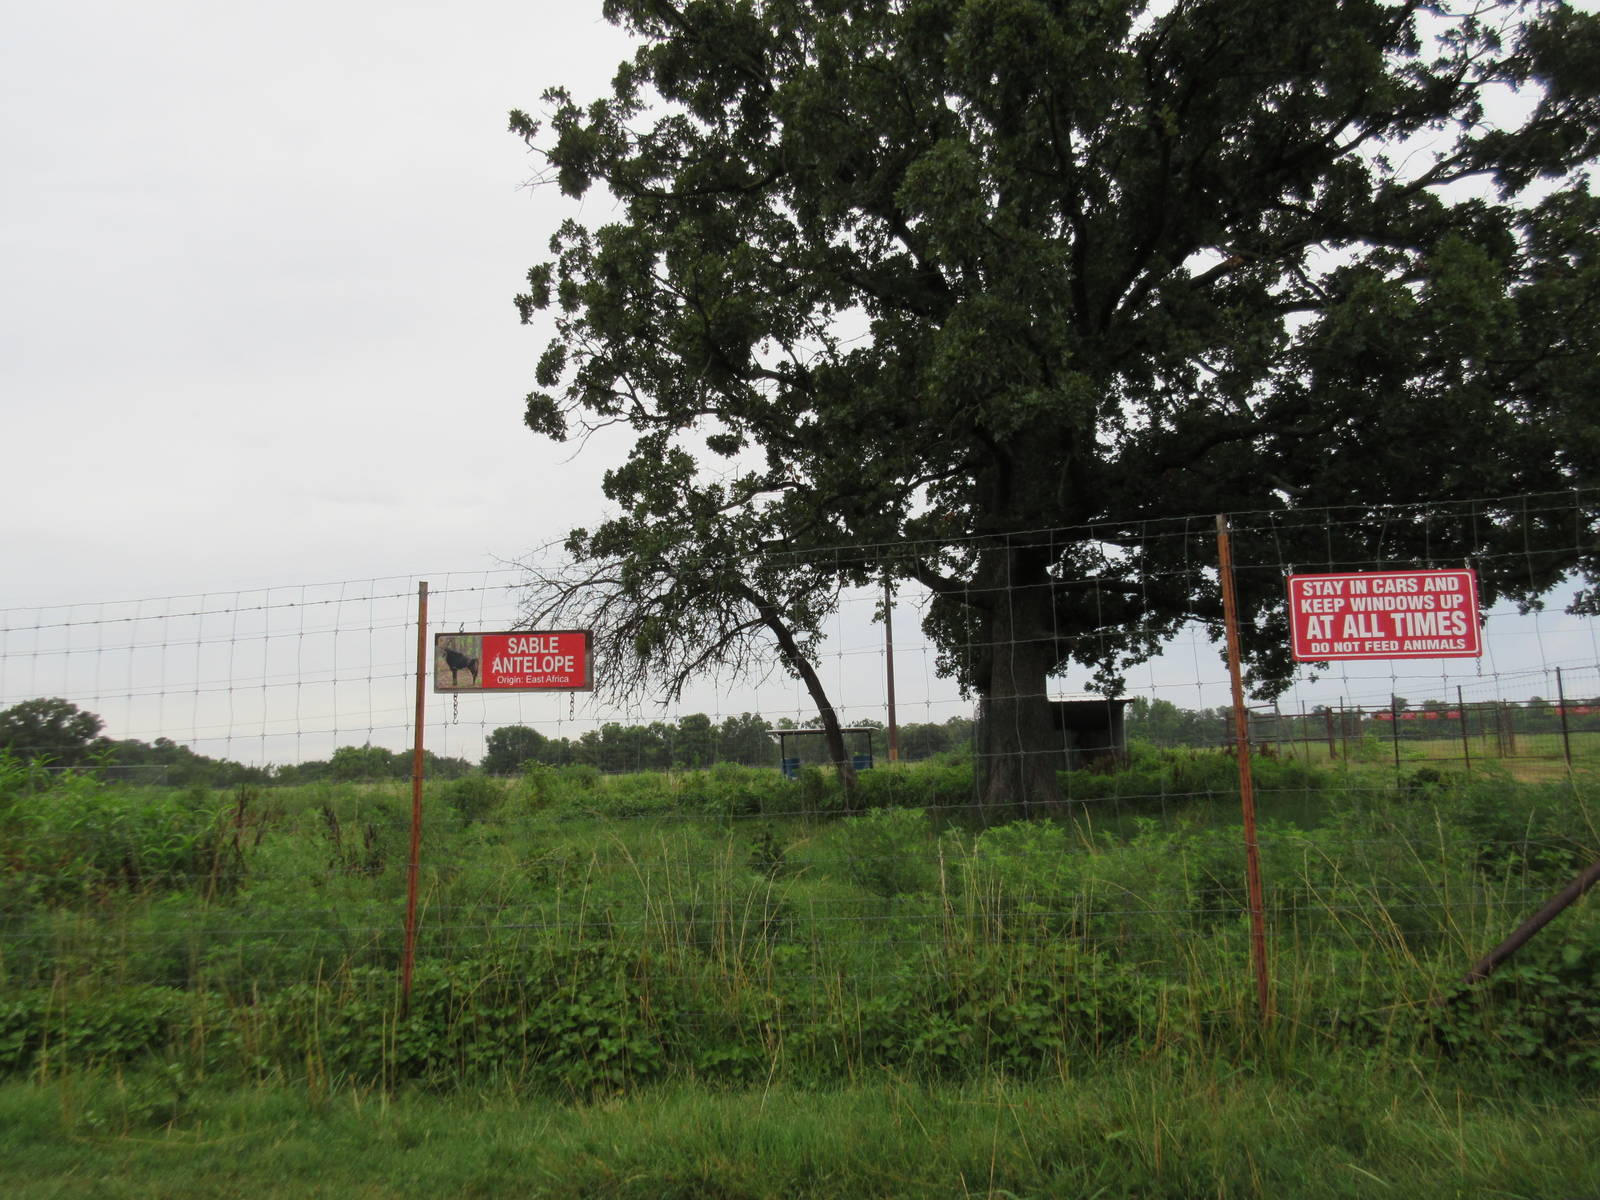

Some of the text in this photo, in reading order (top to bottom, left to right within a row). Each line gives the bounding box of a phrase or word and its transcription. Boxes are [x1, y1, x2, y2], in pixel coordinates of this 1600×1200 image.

[1302, 576, 1459, 596] STAY IN CARS AND
[1301, 594, 1464, 613] KEEP WINDOWS UP
[1306, 611, 1467, 640] AT ALL TIMES
[508, 636, 559, 654] SABLE
[1311, 638, 1466, 653] DO NOT FEED ANIMALS
[492, 655, 575, 673] ANTELOPE
[497, 674, 569, 685] Origin: East Africa
